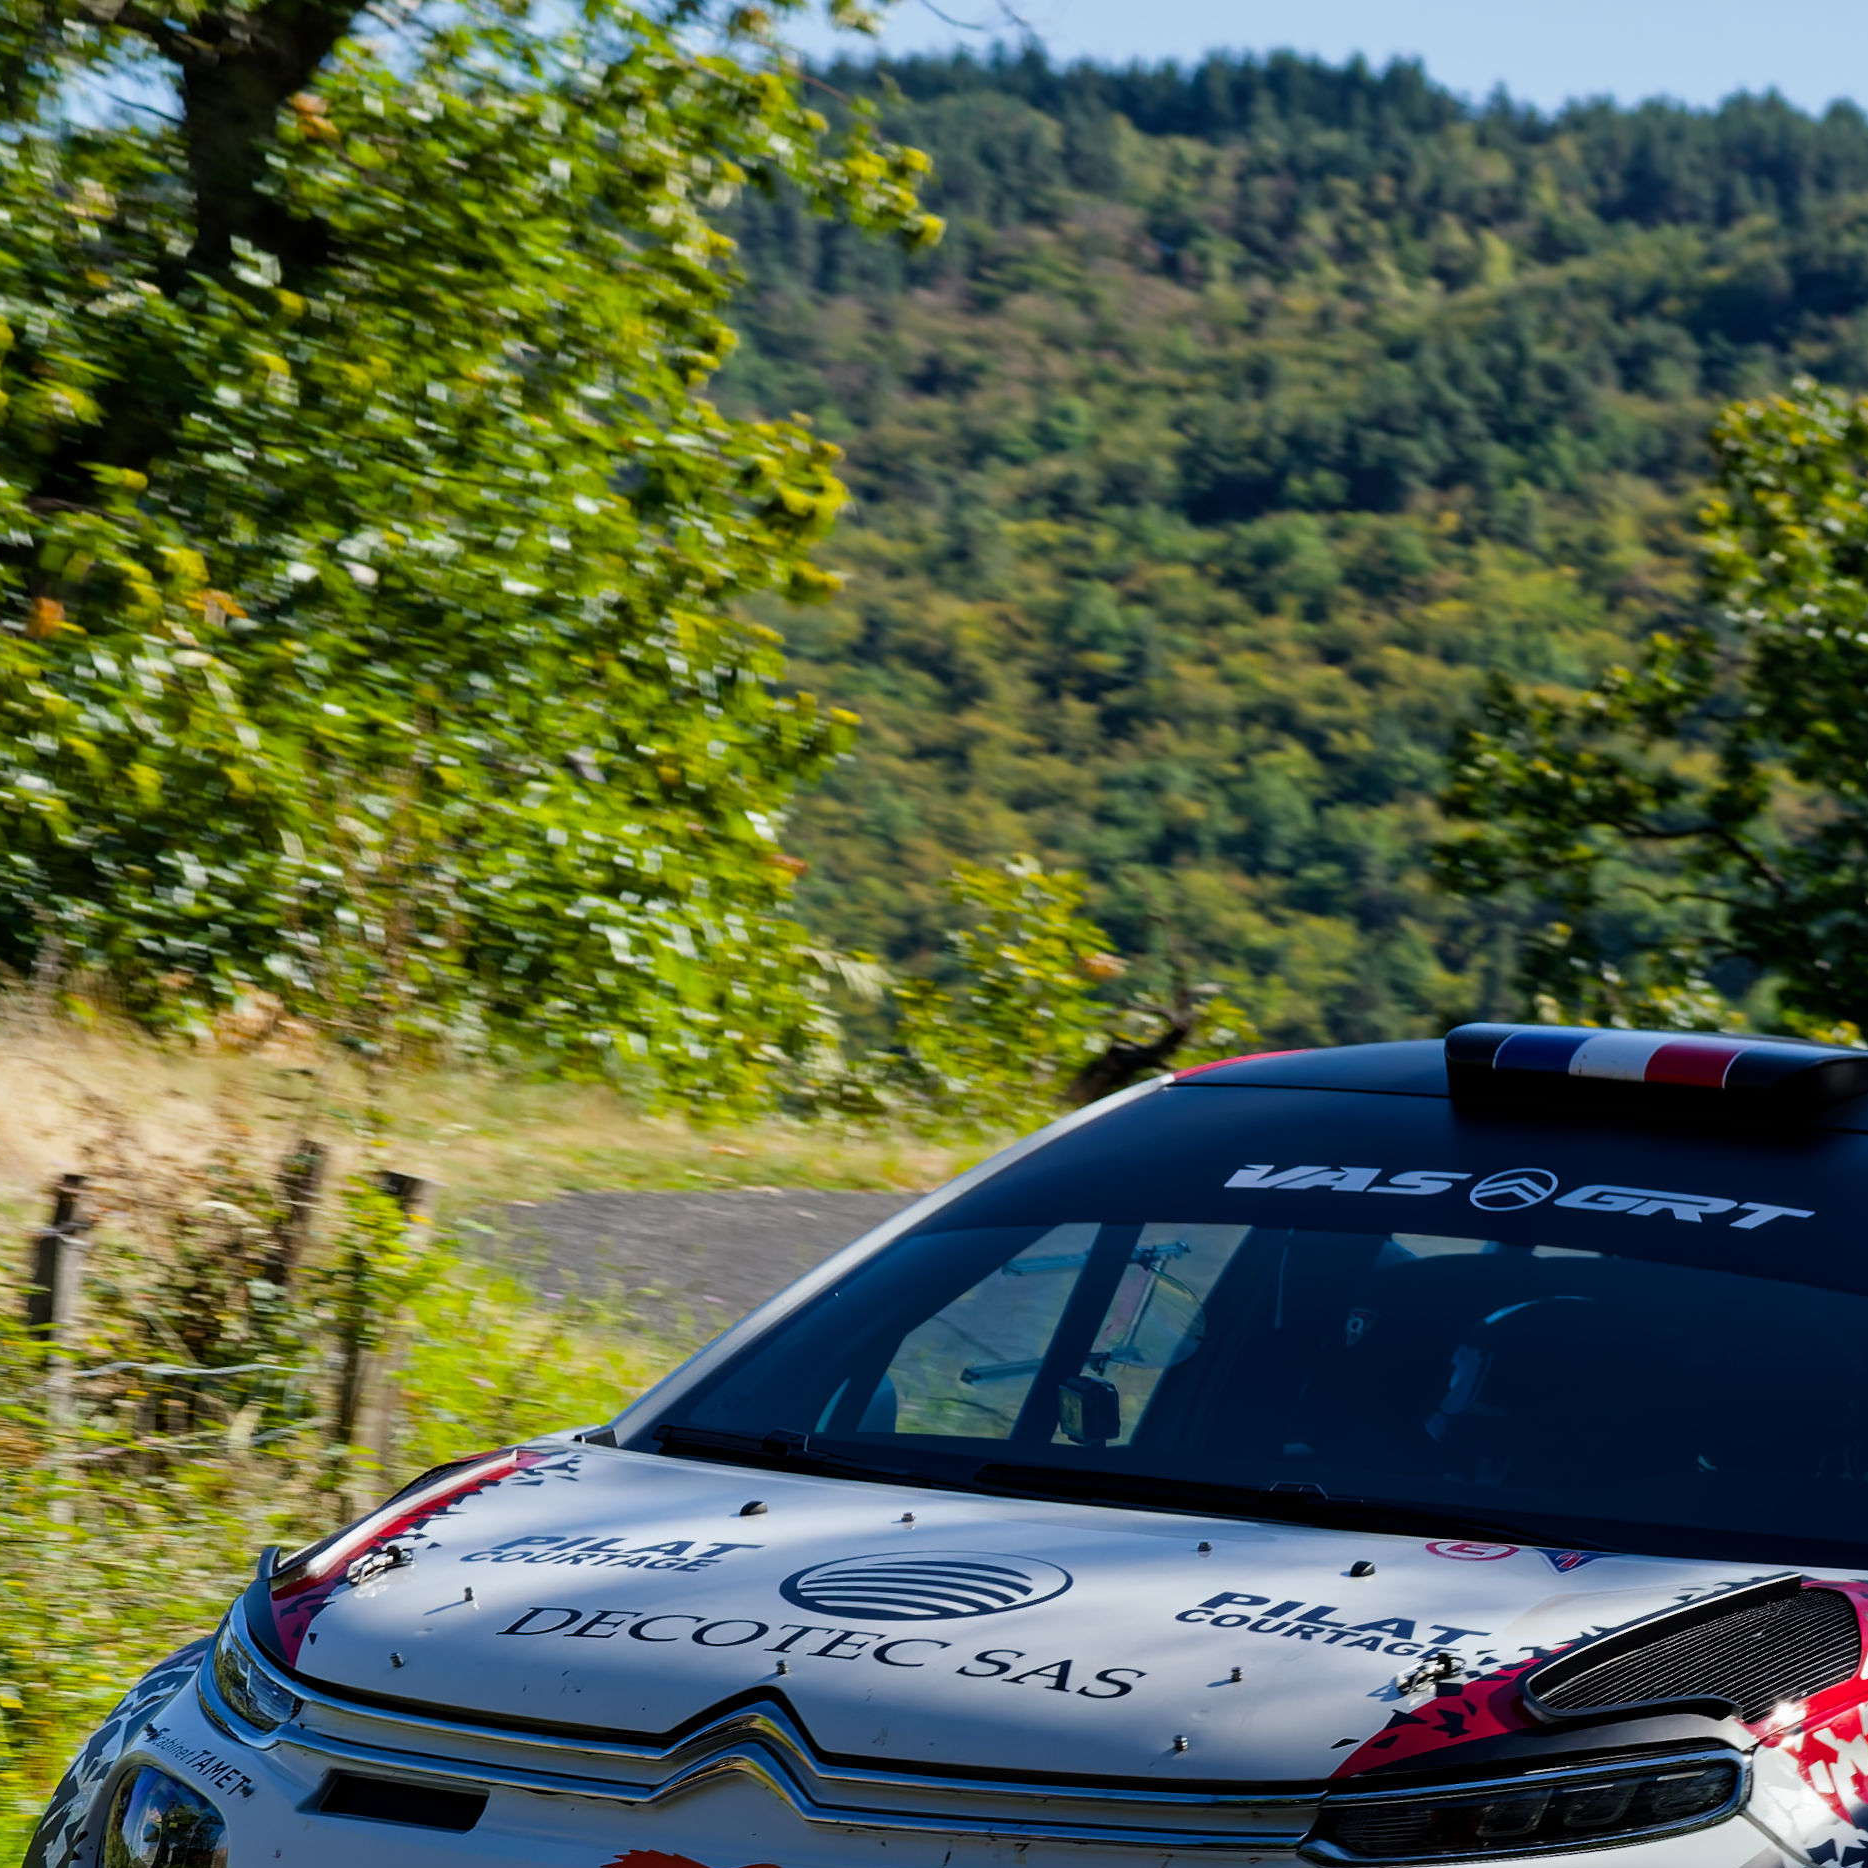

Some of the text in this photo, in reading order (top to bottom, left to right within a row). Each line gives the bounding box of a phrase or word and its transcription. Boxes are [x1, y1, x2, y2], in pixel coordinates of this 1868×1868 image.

[1224, 1163, 1815, 1230] VAS GRT
[459, 1550, 726, 1573] COURTAGE
[490, 1536, 764, 1561] PILAT
[1198, 1592, 1491, 1646] PILAT
[498, 1607, 1147, 1699] DECOTEC SAS
